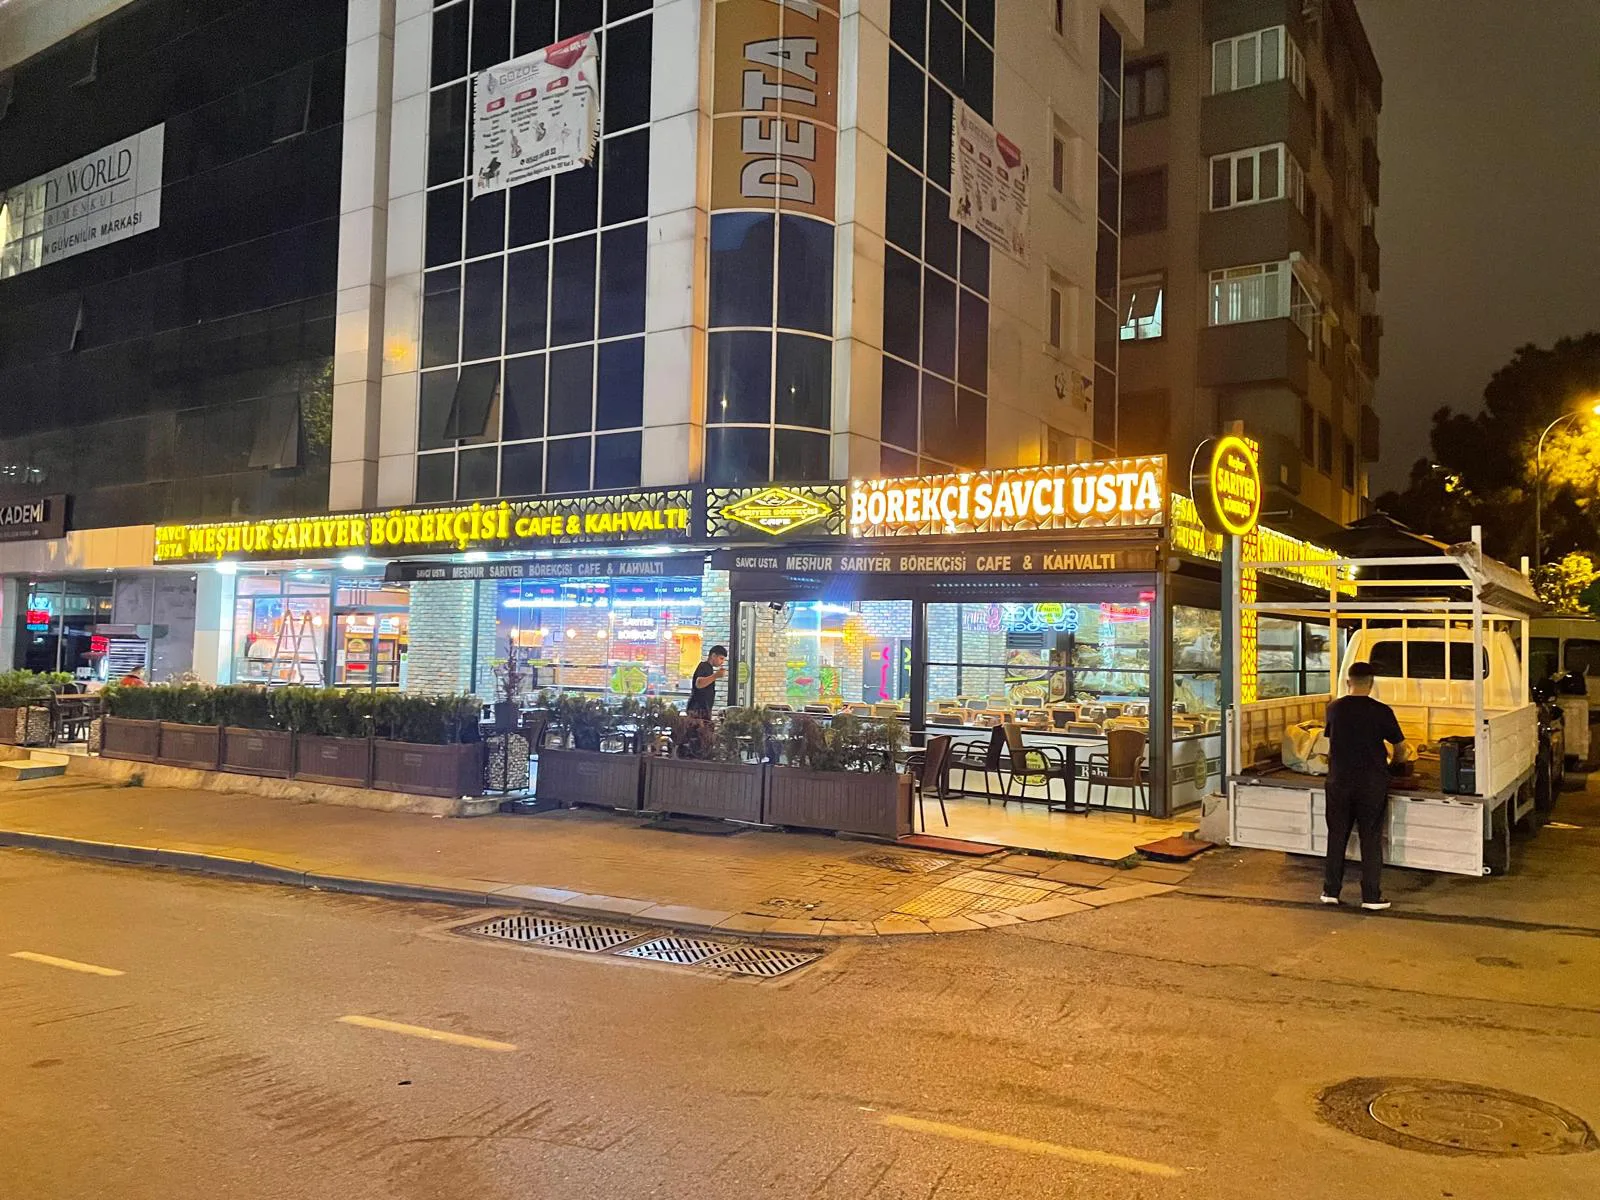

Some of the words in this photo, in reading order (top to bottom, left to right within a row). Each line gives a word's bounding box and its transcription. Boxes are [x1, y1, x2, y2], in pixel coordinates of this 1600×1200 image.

[741, 37, 818, 204] DETA
[67, 149, 132, 195] WORLD
[850, 475, 970, 532] BÖREKÇİ
[974, 477, 1066, 520] SAVCI
[1070, 470, 1161, 515] USTA
[1217, 467, 1256, 501] SARIYER
[156, 526, 186, 541] SAVCI
[188, 525, 270, 560] MEŞHUR
[272, 519, 366, 550] SARIYER
[369, 501, 511, 550] BÖREKÇİSİ
[515, 515, 564, 537] CAFE
[565, 516, 581, 535] &
[584, 507, 688, 532] KAHVALTI
[156, 543, 184, 557] USTA
[735, 556, 757, 568] SAVCI
[758, 557, 778, 569] USTA
[786, 556, 832, 572] MEŞHUR
[840, 557, 891, 571] SARIYER
[976, 556, 1011, 571] CAFE
[1022, 555, 1033, 570] &
[1043, 553, 1116, 570] KAHVALTI
[452, 566, 484, 578] MEŞHUR
[489, 565, 524, 577] SARIYER
[578, 563, 601, 575] CAFE
[606, 562, 614, 574] &
[619, 561, 664, 574] KAHVALTI
